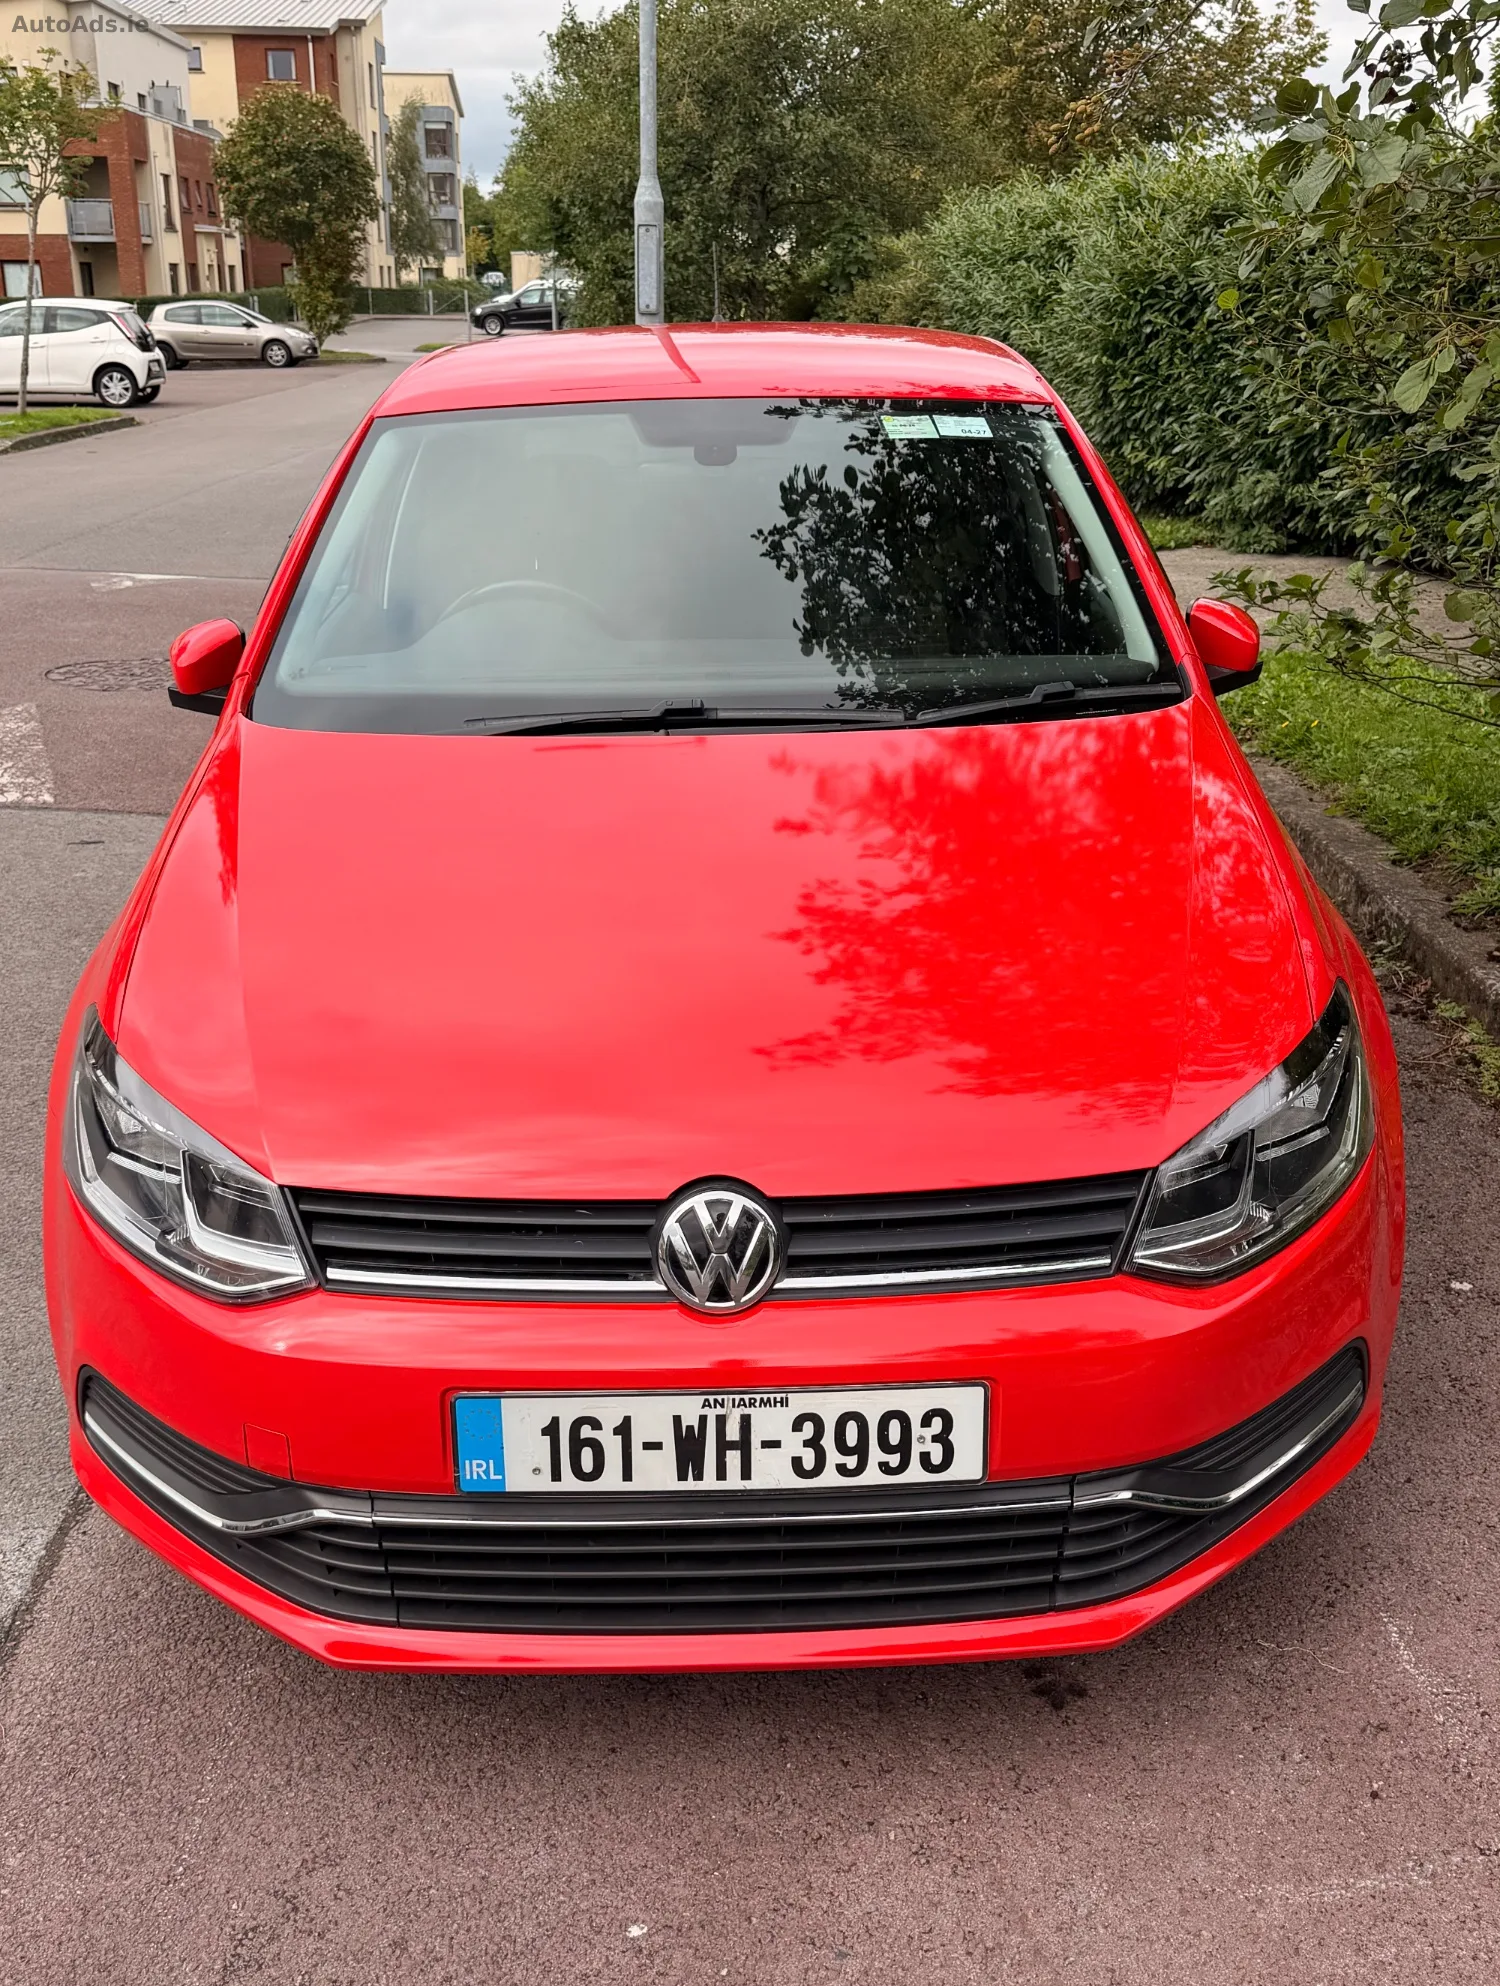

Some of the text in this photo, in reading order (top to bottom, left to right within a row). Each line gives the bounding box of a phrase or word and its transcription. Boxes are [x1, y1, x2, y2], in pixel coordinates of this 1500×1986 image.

[701, 1393, 789, 1410] AN IARMHÍ
[541, 1408, 955, 1482] 161-WH-3993
[464, 1459, 503, 1480] IRL
